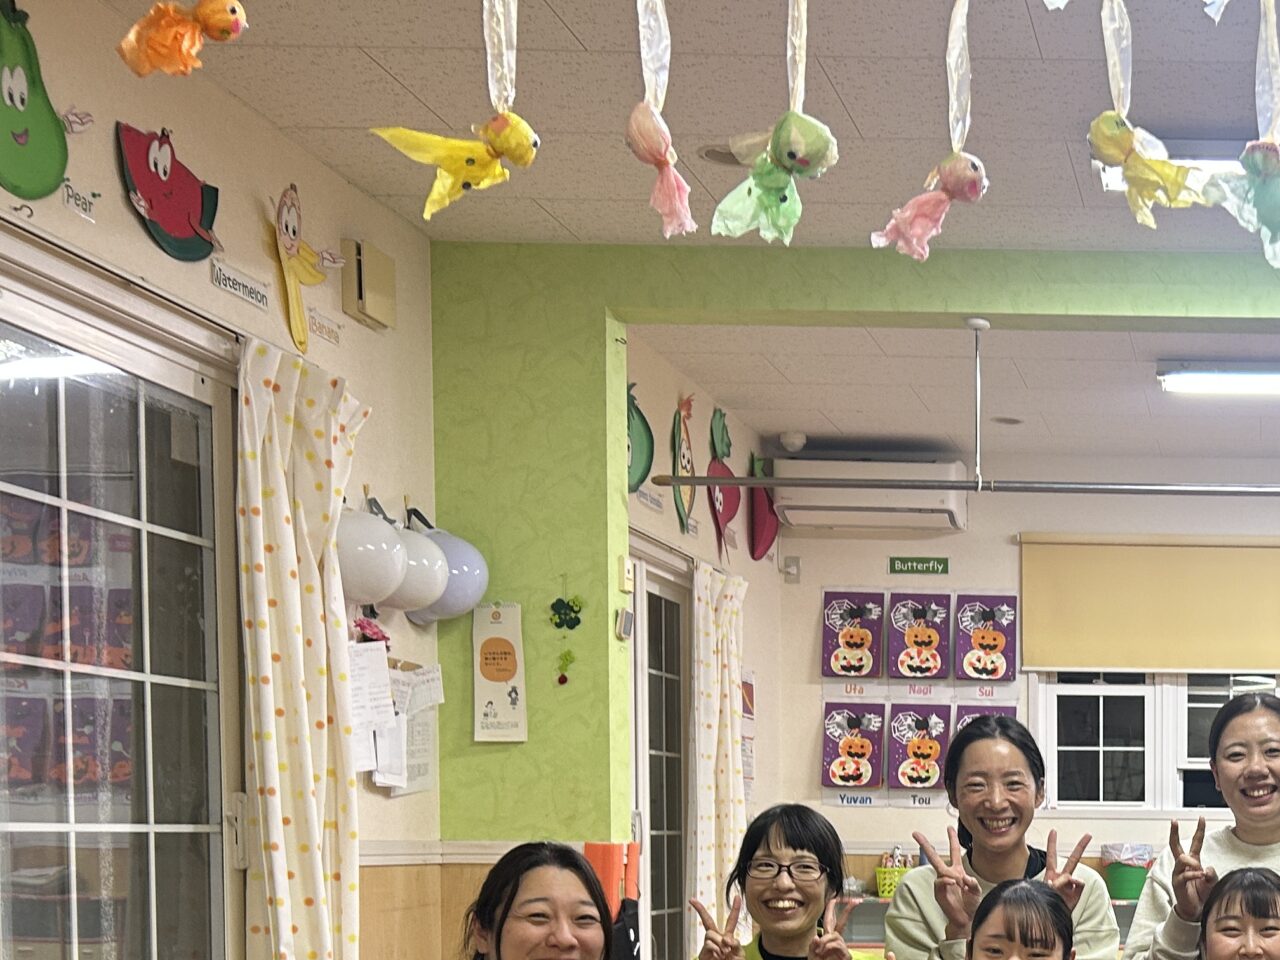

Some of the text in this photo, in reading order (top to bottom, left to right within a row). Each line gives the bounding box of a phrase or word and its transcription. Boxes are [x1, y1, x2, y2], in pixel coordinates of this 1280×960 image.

[65, 183, 93, 214] Pear
[211, 261, 269, 307] Watermelon
[895, 560, 944, 573] Butterfly
[845, 684, 864, 695] Uta
[909, 684, 932, 695] Nagi
[839, 794, 872, 805] Yuvan
[911, 795, 931, 805] Tou
